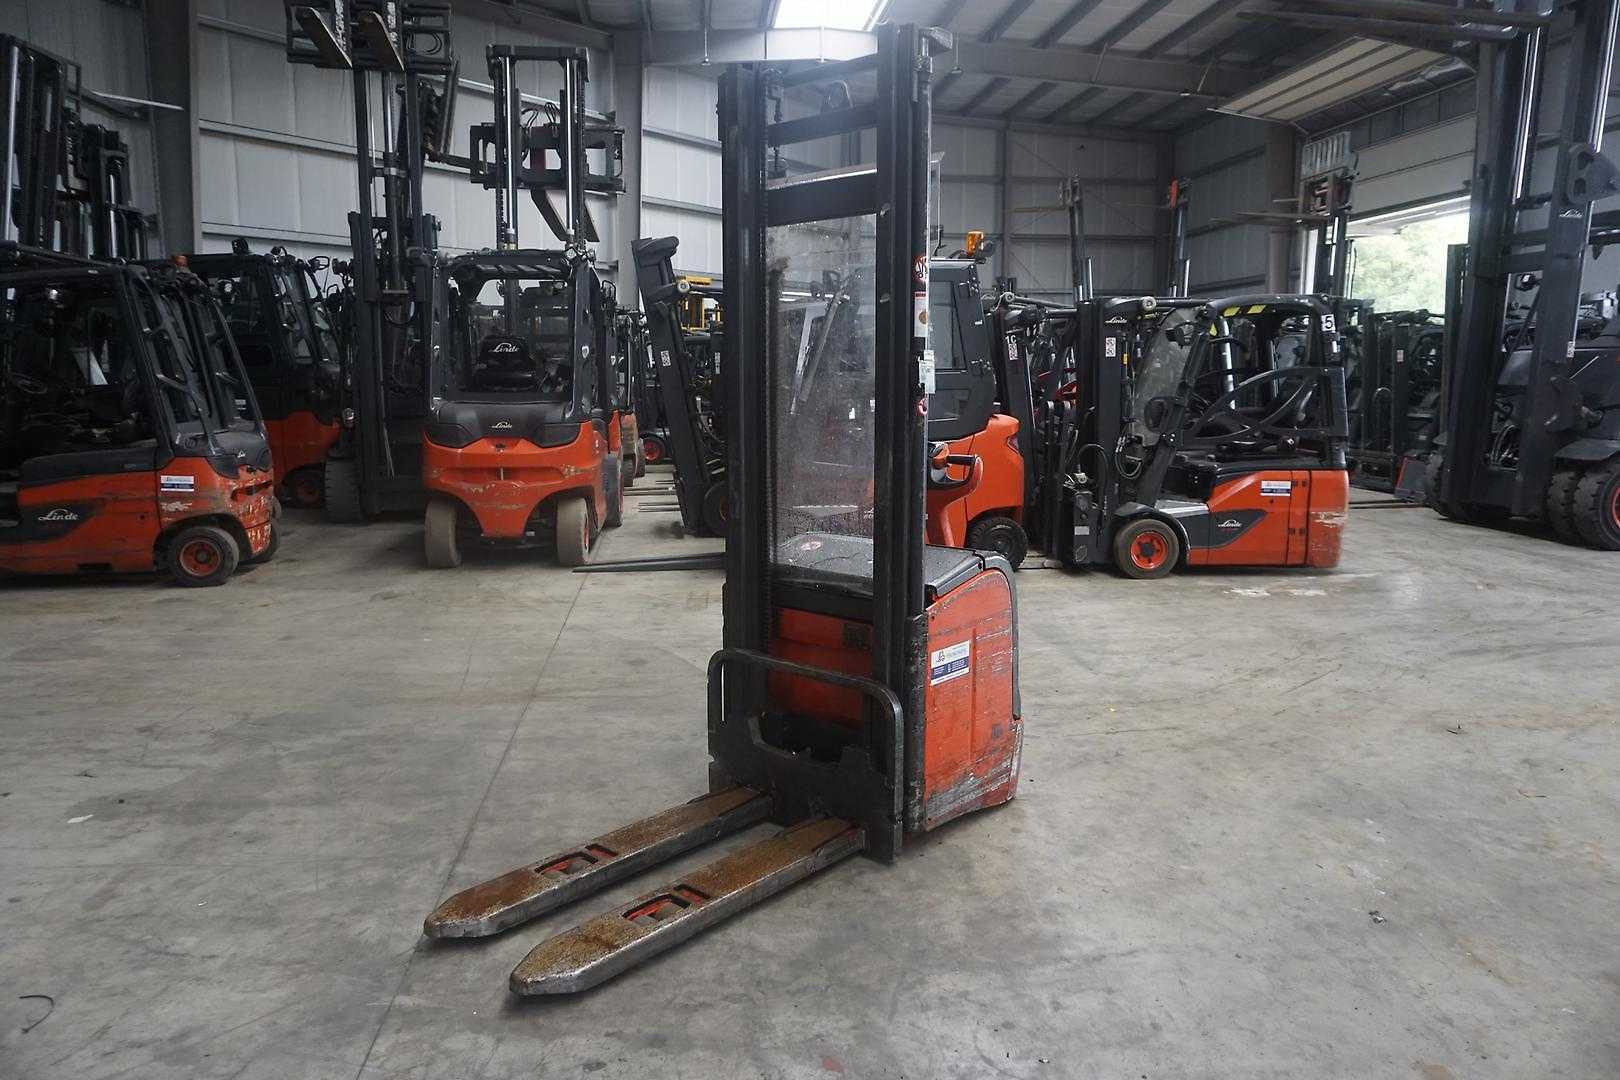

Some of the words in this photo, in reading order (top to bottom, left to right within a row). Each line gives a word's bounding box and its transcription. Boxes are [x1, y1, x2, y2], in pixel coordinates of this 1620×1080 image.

[1325, 315, 1334, 330] 5
[488, 342, 520, 353] Linde
[38, 508, 80, 521] Linde
